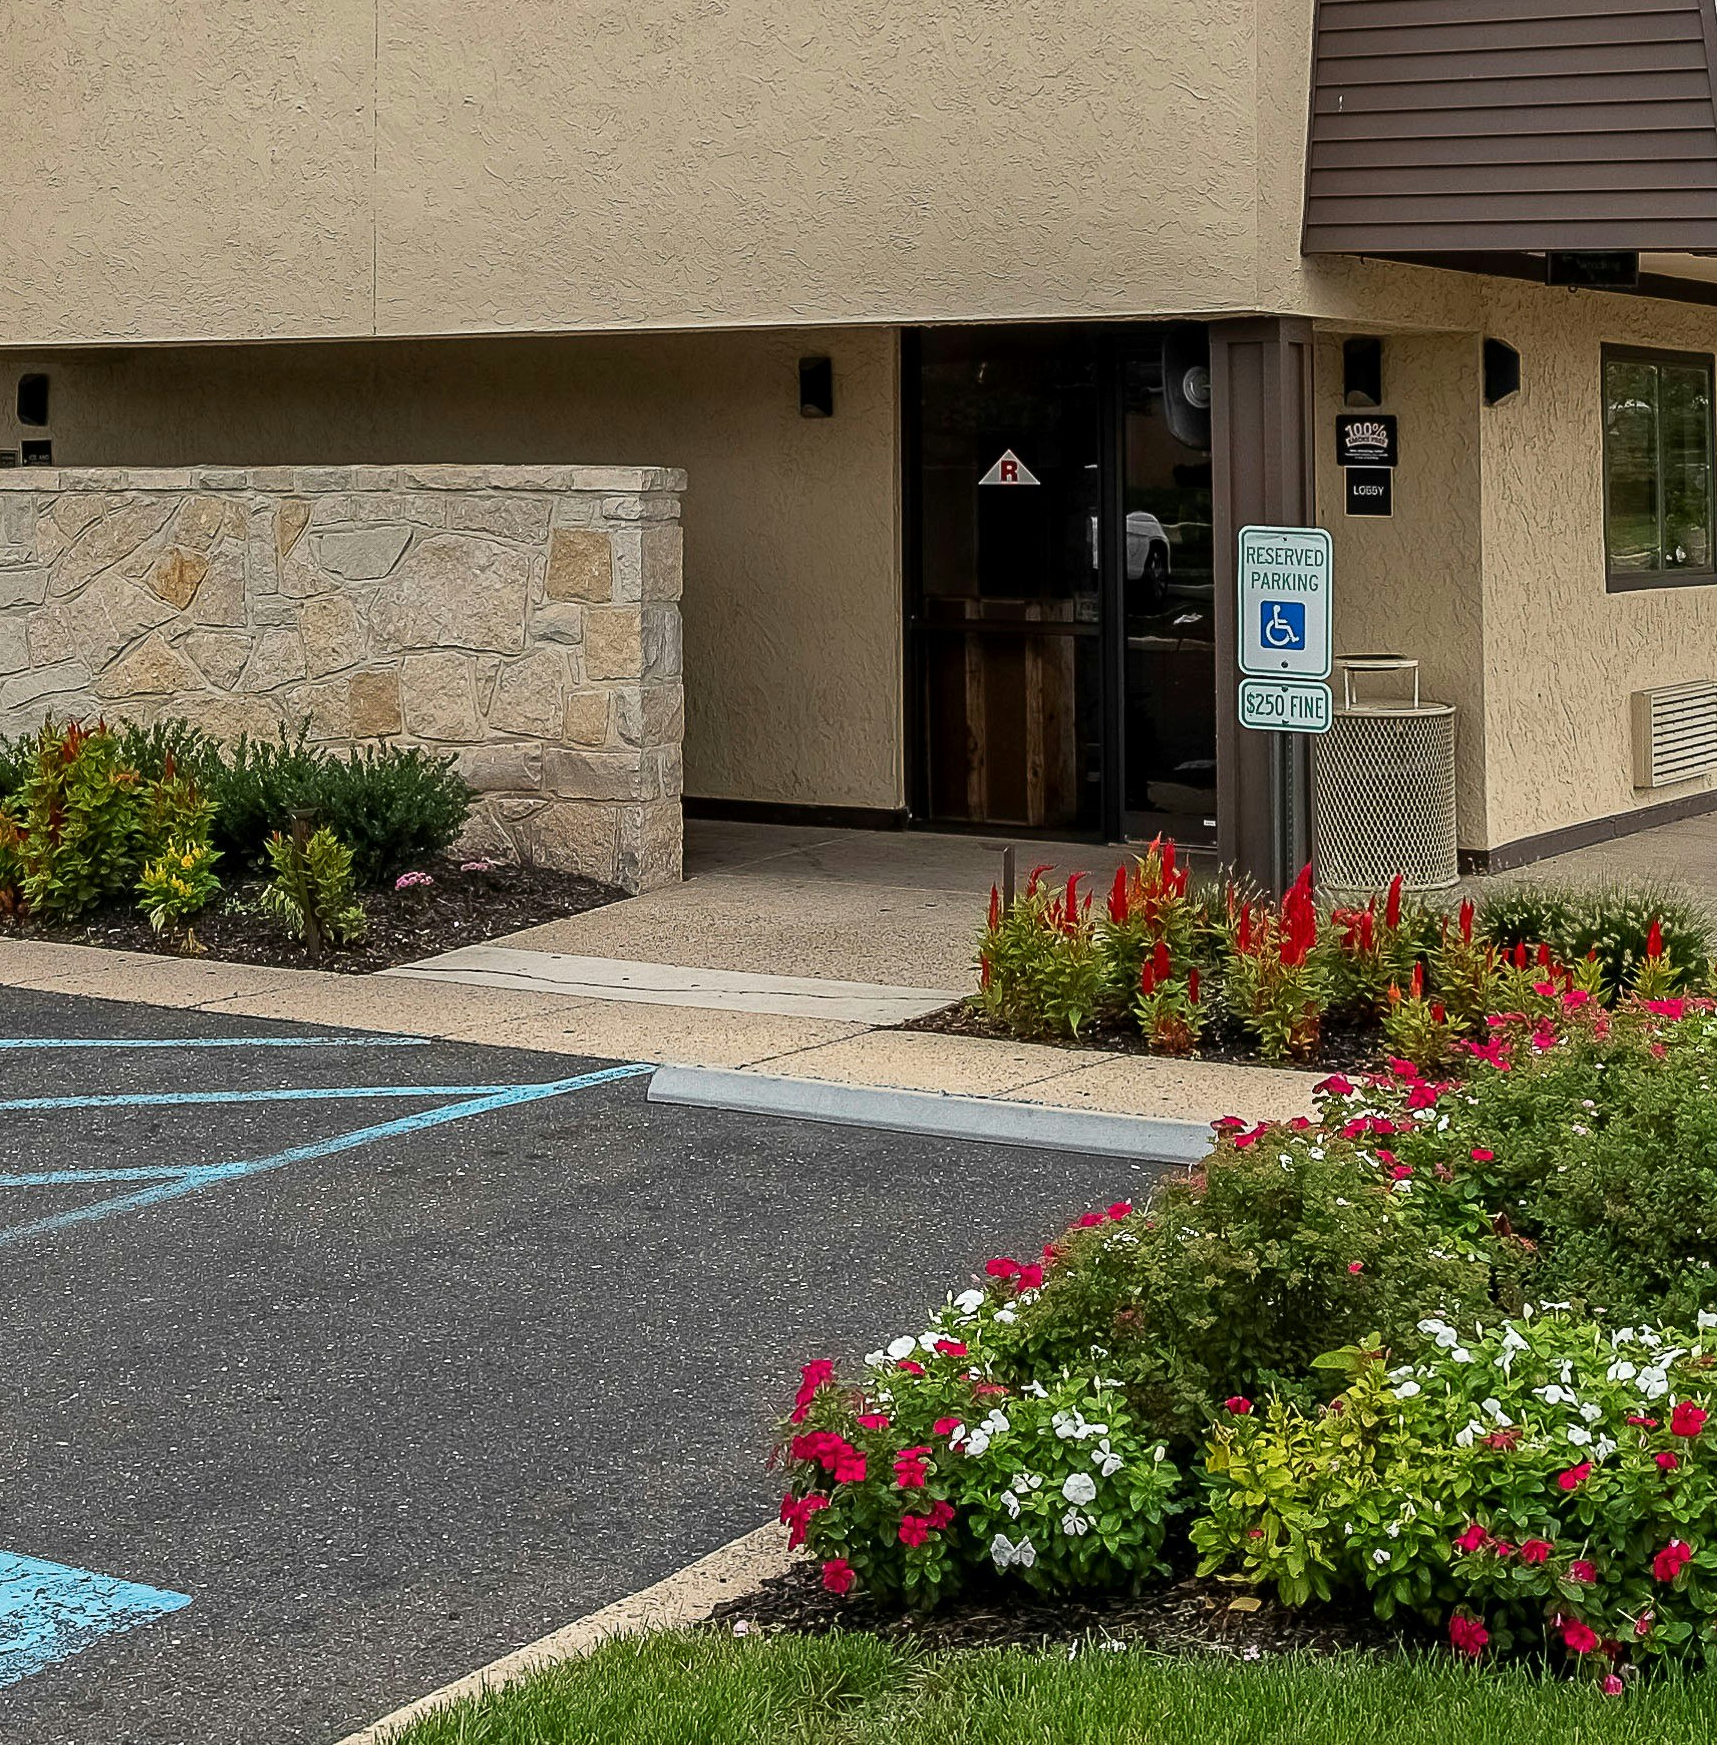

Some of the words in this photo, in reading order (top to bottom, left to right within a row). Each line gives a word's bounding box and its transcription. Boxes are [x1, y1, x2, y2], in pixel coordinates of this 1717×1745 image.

[1344, 422, 1387, 438] 100%
[1001, 460, 1018, 482] R
[1353, 485, 1384, 496] LOBBY
[1246, 546, 1324, 567] RESERVED
[1251, 571, 1319, 592] PARKING
[1246, 692, 1285, 717] $250
[1290, 696, 1324, 719] FINE
